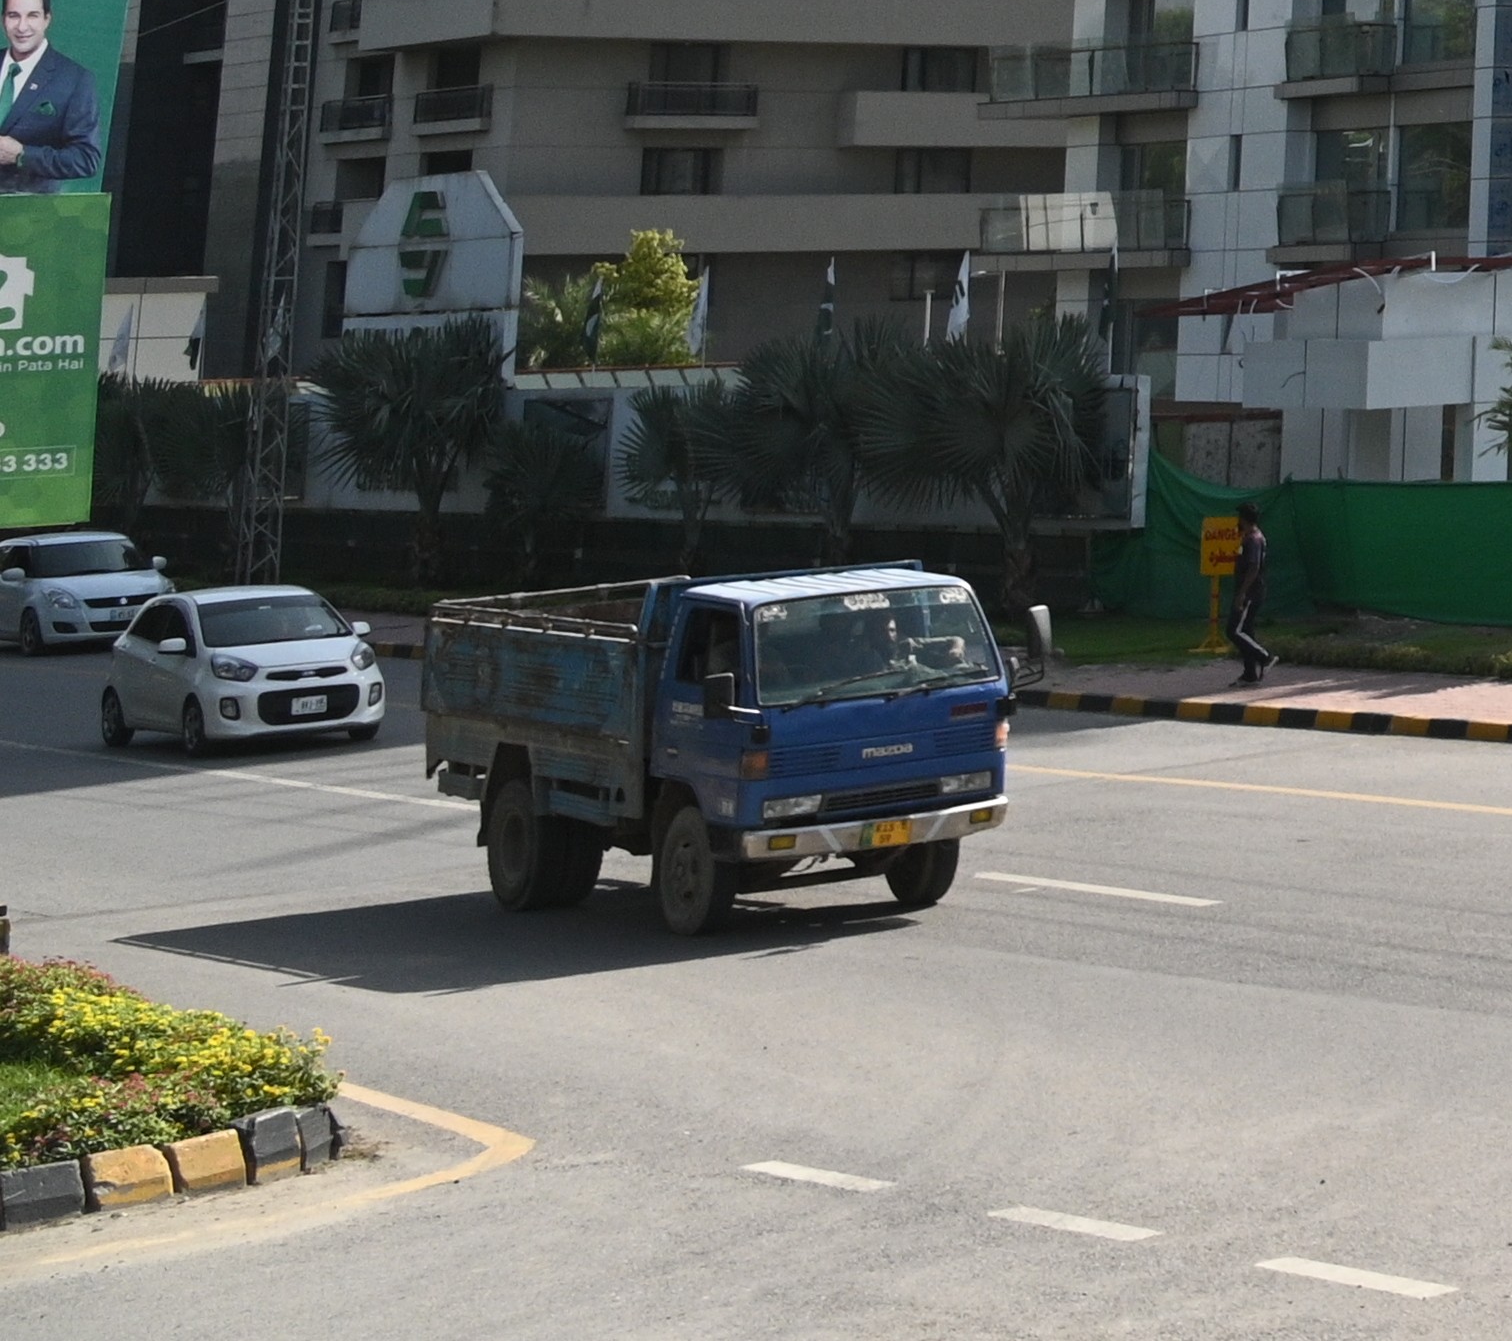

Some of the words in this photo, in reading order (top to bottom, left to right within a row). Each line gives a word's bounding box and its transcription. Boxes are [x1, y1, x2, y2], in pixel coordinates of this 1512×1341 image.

[18, 359, 53, 372] Pata
[58, 358, 84, 370] Hai
[23, 452, 68, 472] 333
[1205, 528, 1242, 541] DANGE
